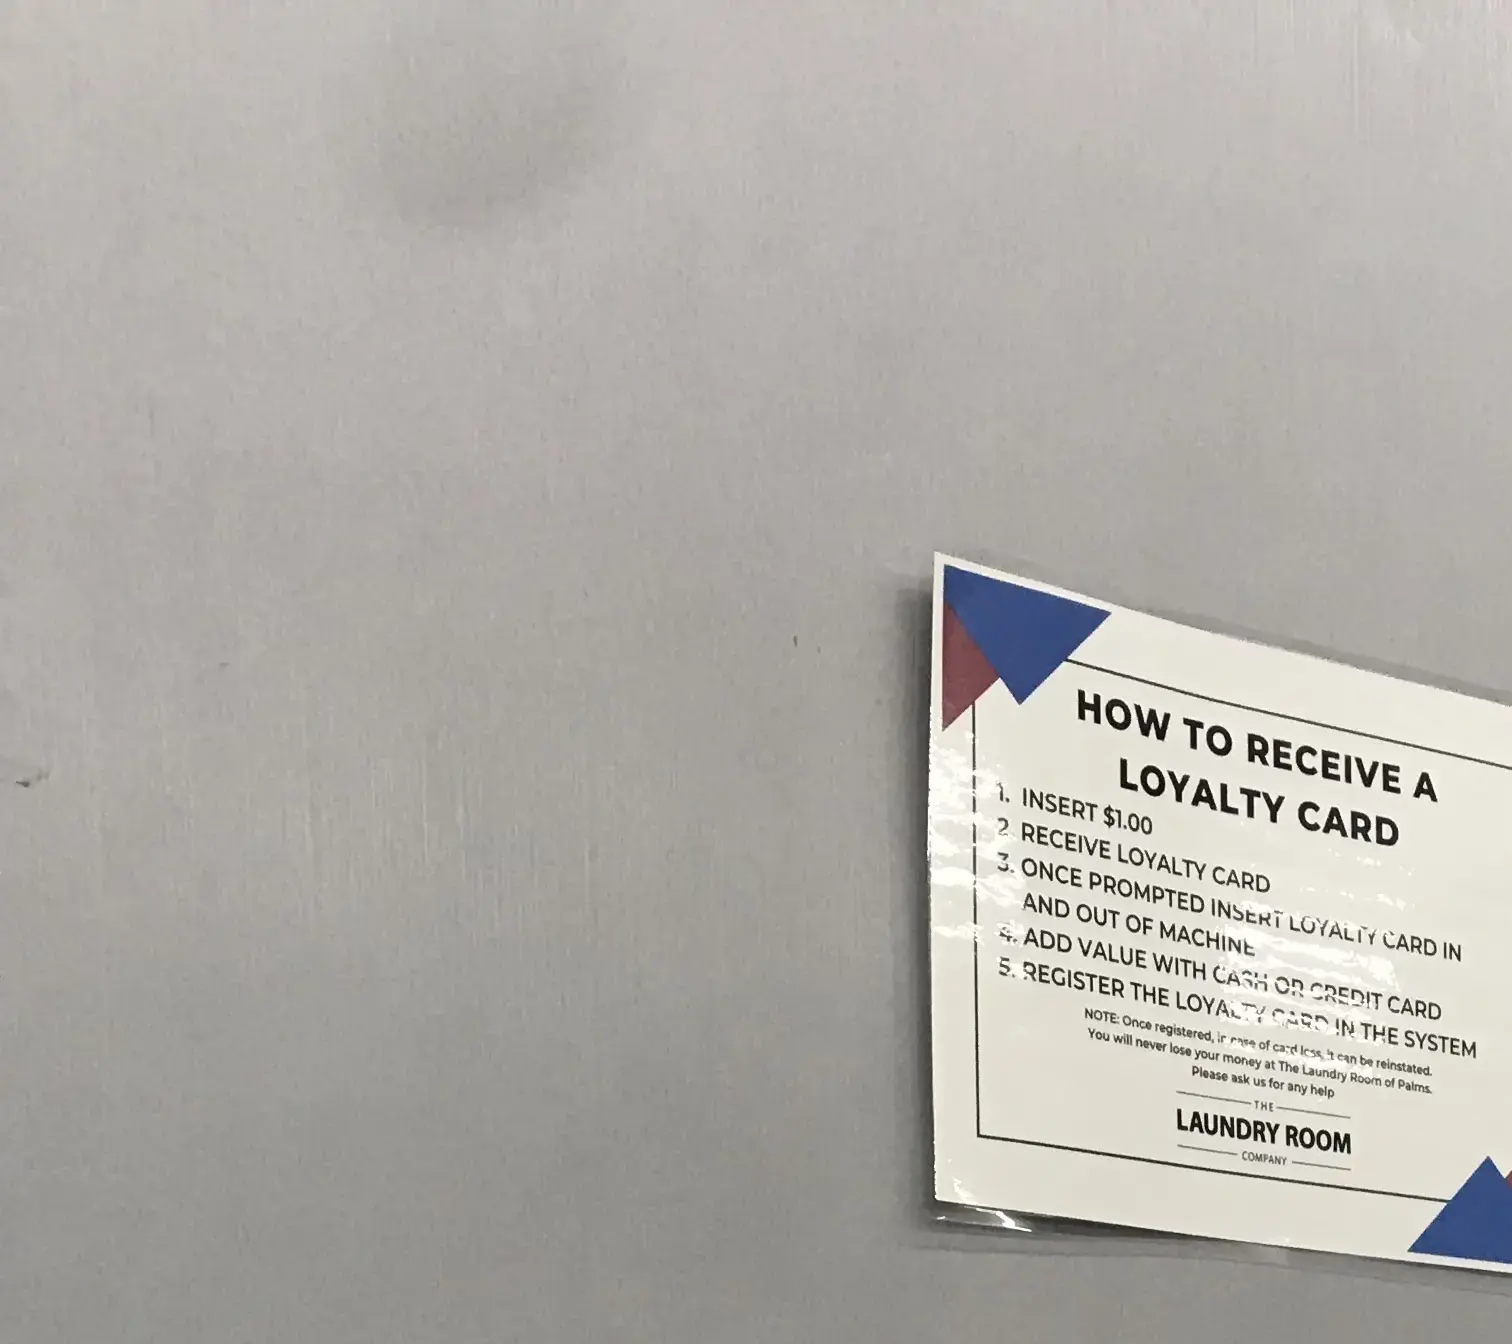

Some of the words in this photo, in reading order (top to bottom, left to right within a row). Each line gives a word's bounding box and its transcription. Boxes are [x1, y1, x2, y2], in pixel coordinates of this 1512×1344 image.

[1079, 690, 1170, 741] HOW
[1183, 718, 1232, 755] TO
[1248, 734, 1401, 794] RECEIVE
[1413, 772, 1437, 802] A
[1023, 788, 1098, 821] INSERT
[1104, 806, 1152, 834] $1.00
[1120, 758, 1285, 823] LOYALTY
[1298, 802, 1398, 846] CARD
[1022, 822, 1111, 859] RECEIVE
[1118, 844, 1206, 880] LOYALTY
[1213, 866, 1270, 892] CARD
[1022, 858, 1082, 887] ONCE
[1090, 872, 1204, 913] PROMPTED
[1212, 899, 1283, 928] INSERT
[1383, 932, 1437, 956] CARD
[1444, 942, 1461, 961] IN
[1024, 893, 1069, 918] AND
[1077, 904, 1120, 928] OUT
[1126, 915, 1153, 935] OF
[1024, 928, 1072, 952] ADD
[1078, 937, 1147, 968] VALUE
[1153, 953, 1206, 980] WITH
[1388, 996, 1441, 1020] CARD
[1024, 962, 1124, 998] REGISTER
[1130, 982, 1169, 1006] THE
[1405, 1030, 1476, 1058] SYSTEM
[1085, 1008, 1119, 1024] NOTE:
[1123, 1015, 1152, 1030] Once
[1155, 1024, 1214, 1043] registered,
[1376, 1059, 1432, 1076] reinstated.
[1088, 1028, 1109, 1041] You
[1114, 1034, 1132, 1045] will
[1136, 1039, 1167, 1052] never
[1170, 1043, 1191, 1056] lose
[1195, 1049, 1219, 1061] your
[1223, 1054, 1261, 1070] money
[1278, 1060, 1299, 1073] The
[1302, 1065, 1347, 1082] Laundry
[1192, 1066, 1228, 1081] Please
[1232, 1074, 1249, 1084] ask
[1269, 1078, 1284, 1090] for
[1311, 1084, 1334, 1099] help
[1255, 1100, 1273, 1112] THE
[1177, 1109, 1280, 1144] LAUNDRY
[1286, 1125, 1351, 1154] ROOM
[1242, 1151, 1287, 1165] COMPANY
